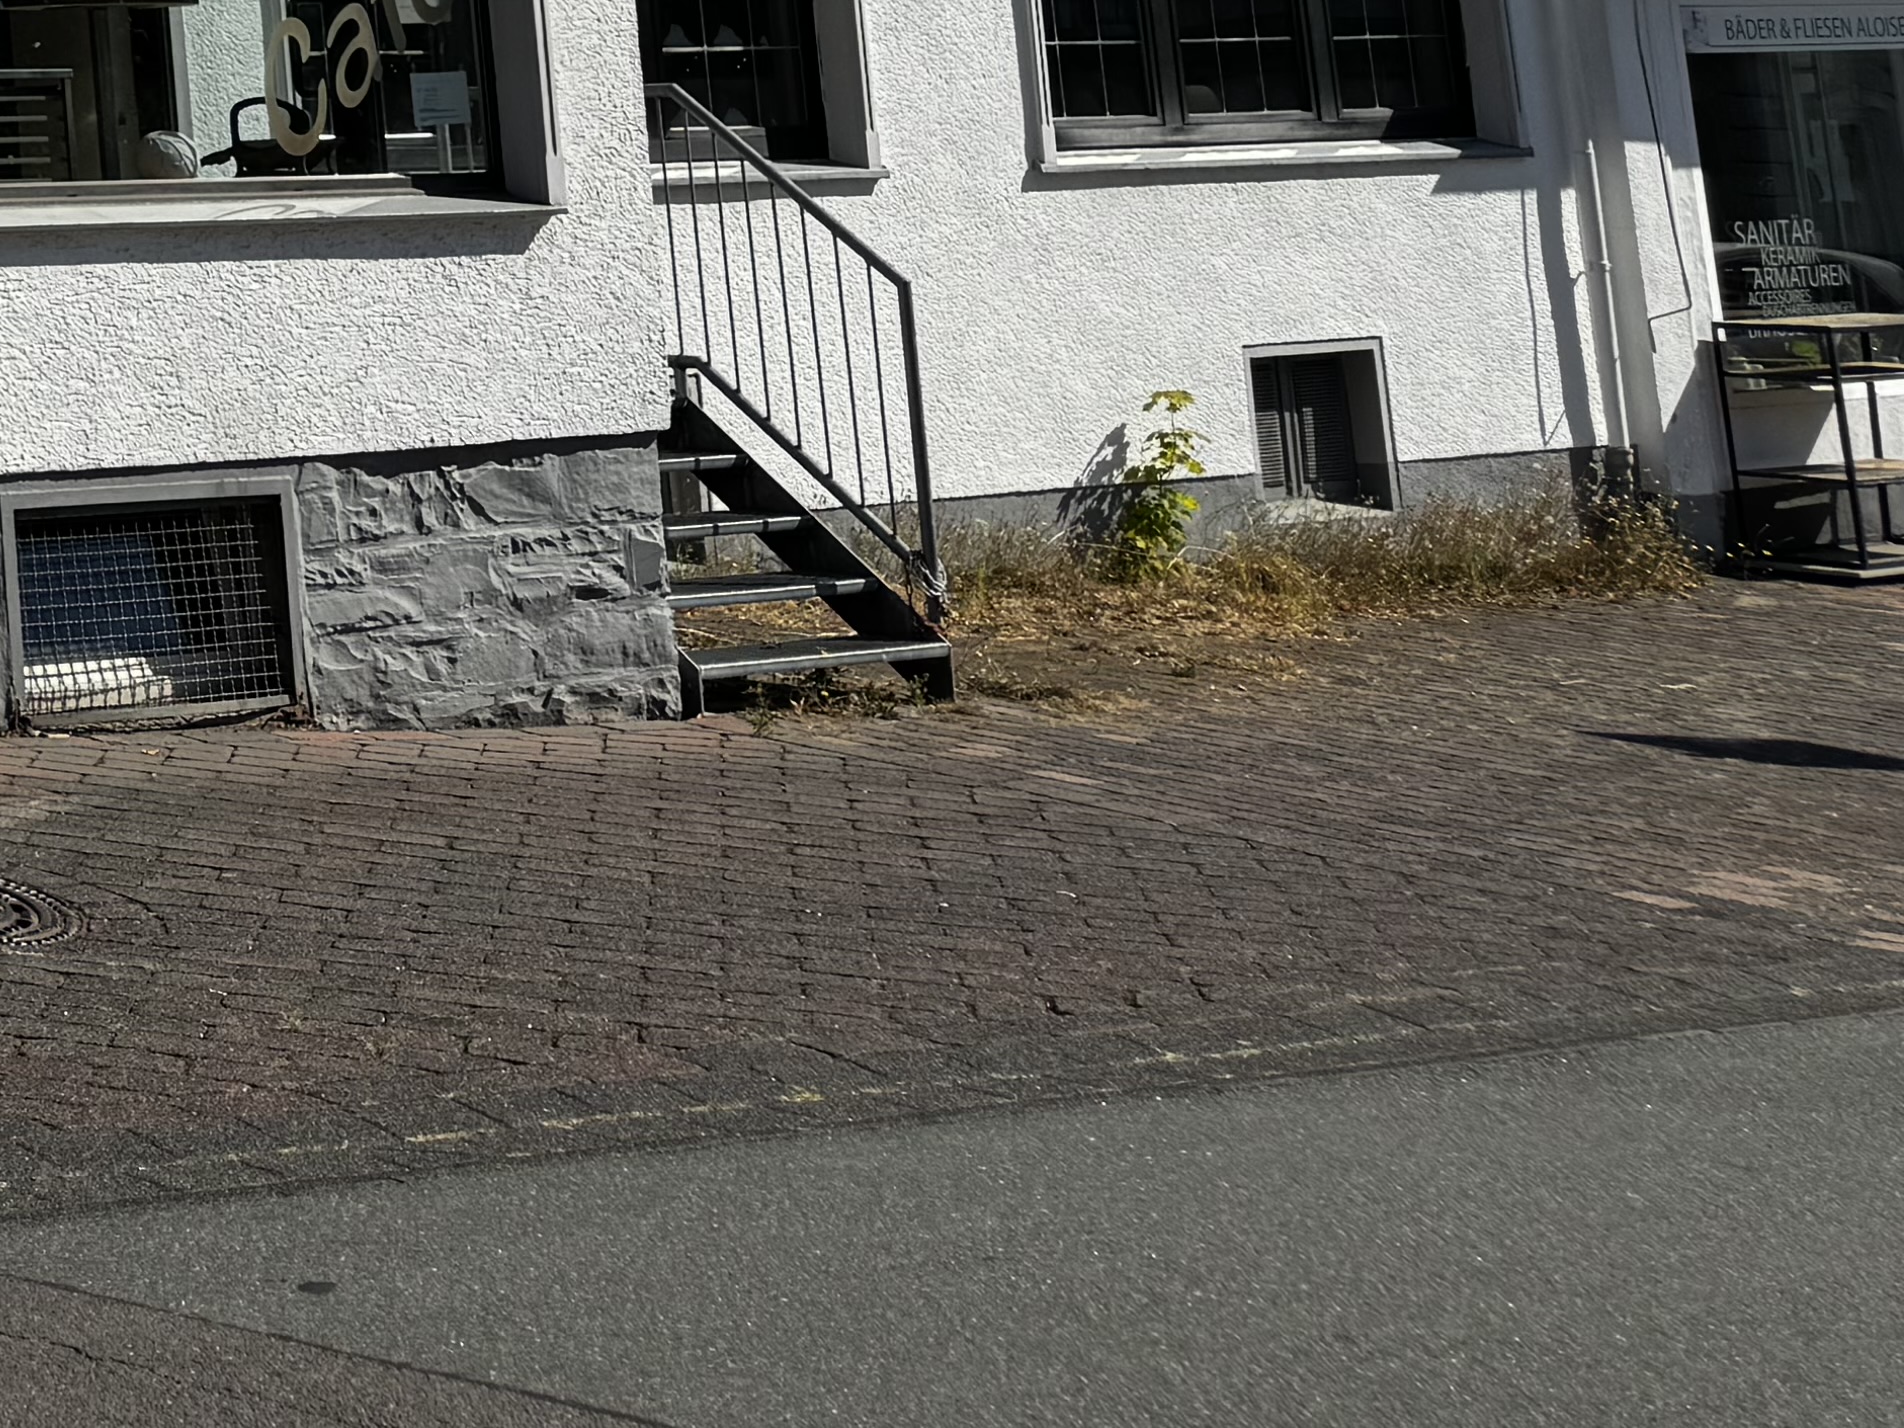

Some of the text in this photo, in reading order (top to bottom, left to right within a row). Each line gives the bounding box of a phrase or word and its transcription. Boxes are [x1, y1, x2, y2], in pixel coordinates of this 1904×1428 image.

[1724, 15, 1777, 41] BÄDER
[1780, 18, 1791, 40] &
[1794, 17, 1853, 40] FLIESEN
[1733, 213, 1818, 246] SANITÄR
[1760, 247, 1821, 266] KERAMIK
[1753, 264, 1852, 290] ARMATUREN
[1748, 289, 1813, 306] ACCESSOIRES
